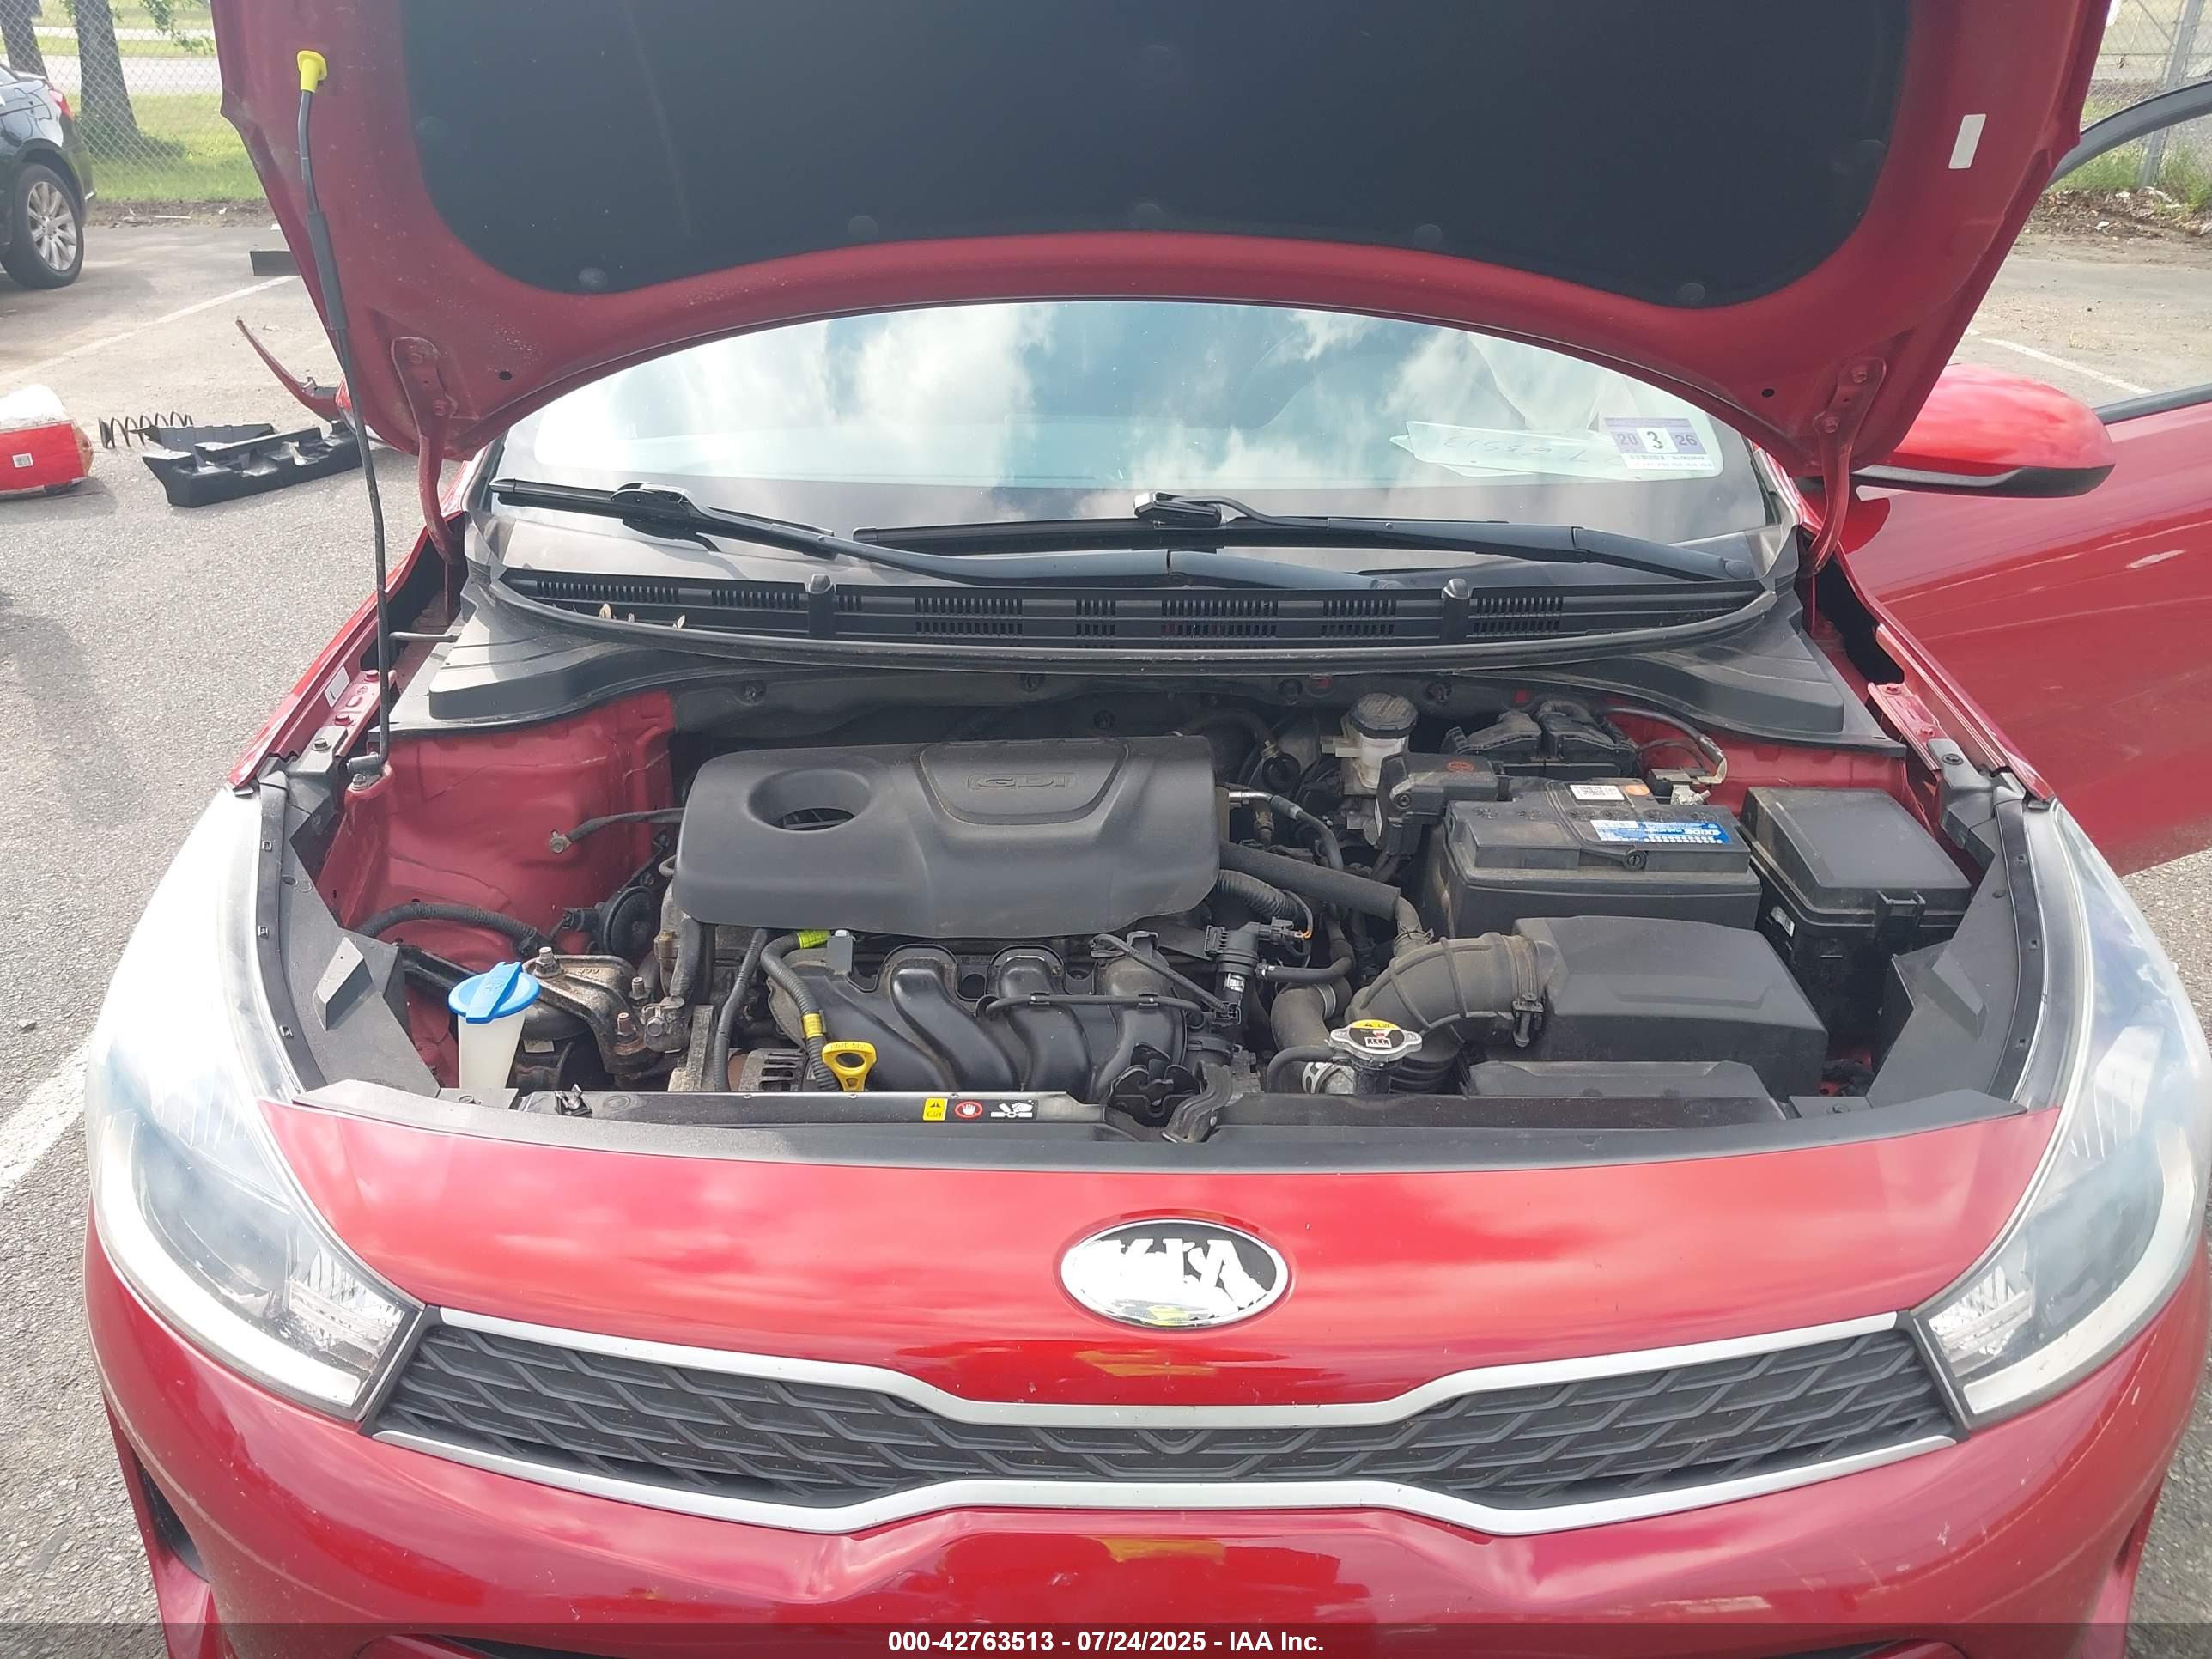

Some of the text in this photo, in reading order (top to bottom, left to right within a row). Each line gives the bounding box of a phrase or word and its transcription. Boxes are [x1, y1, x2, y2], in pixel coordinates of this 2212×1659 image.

[1617, 431, 1698, 449] 20 3 26
[977, 774, 1066, 788] GDI
